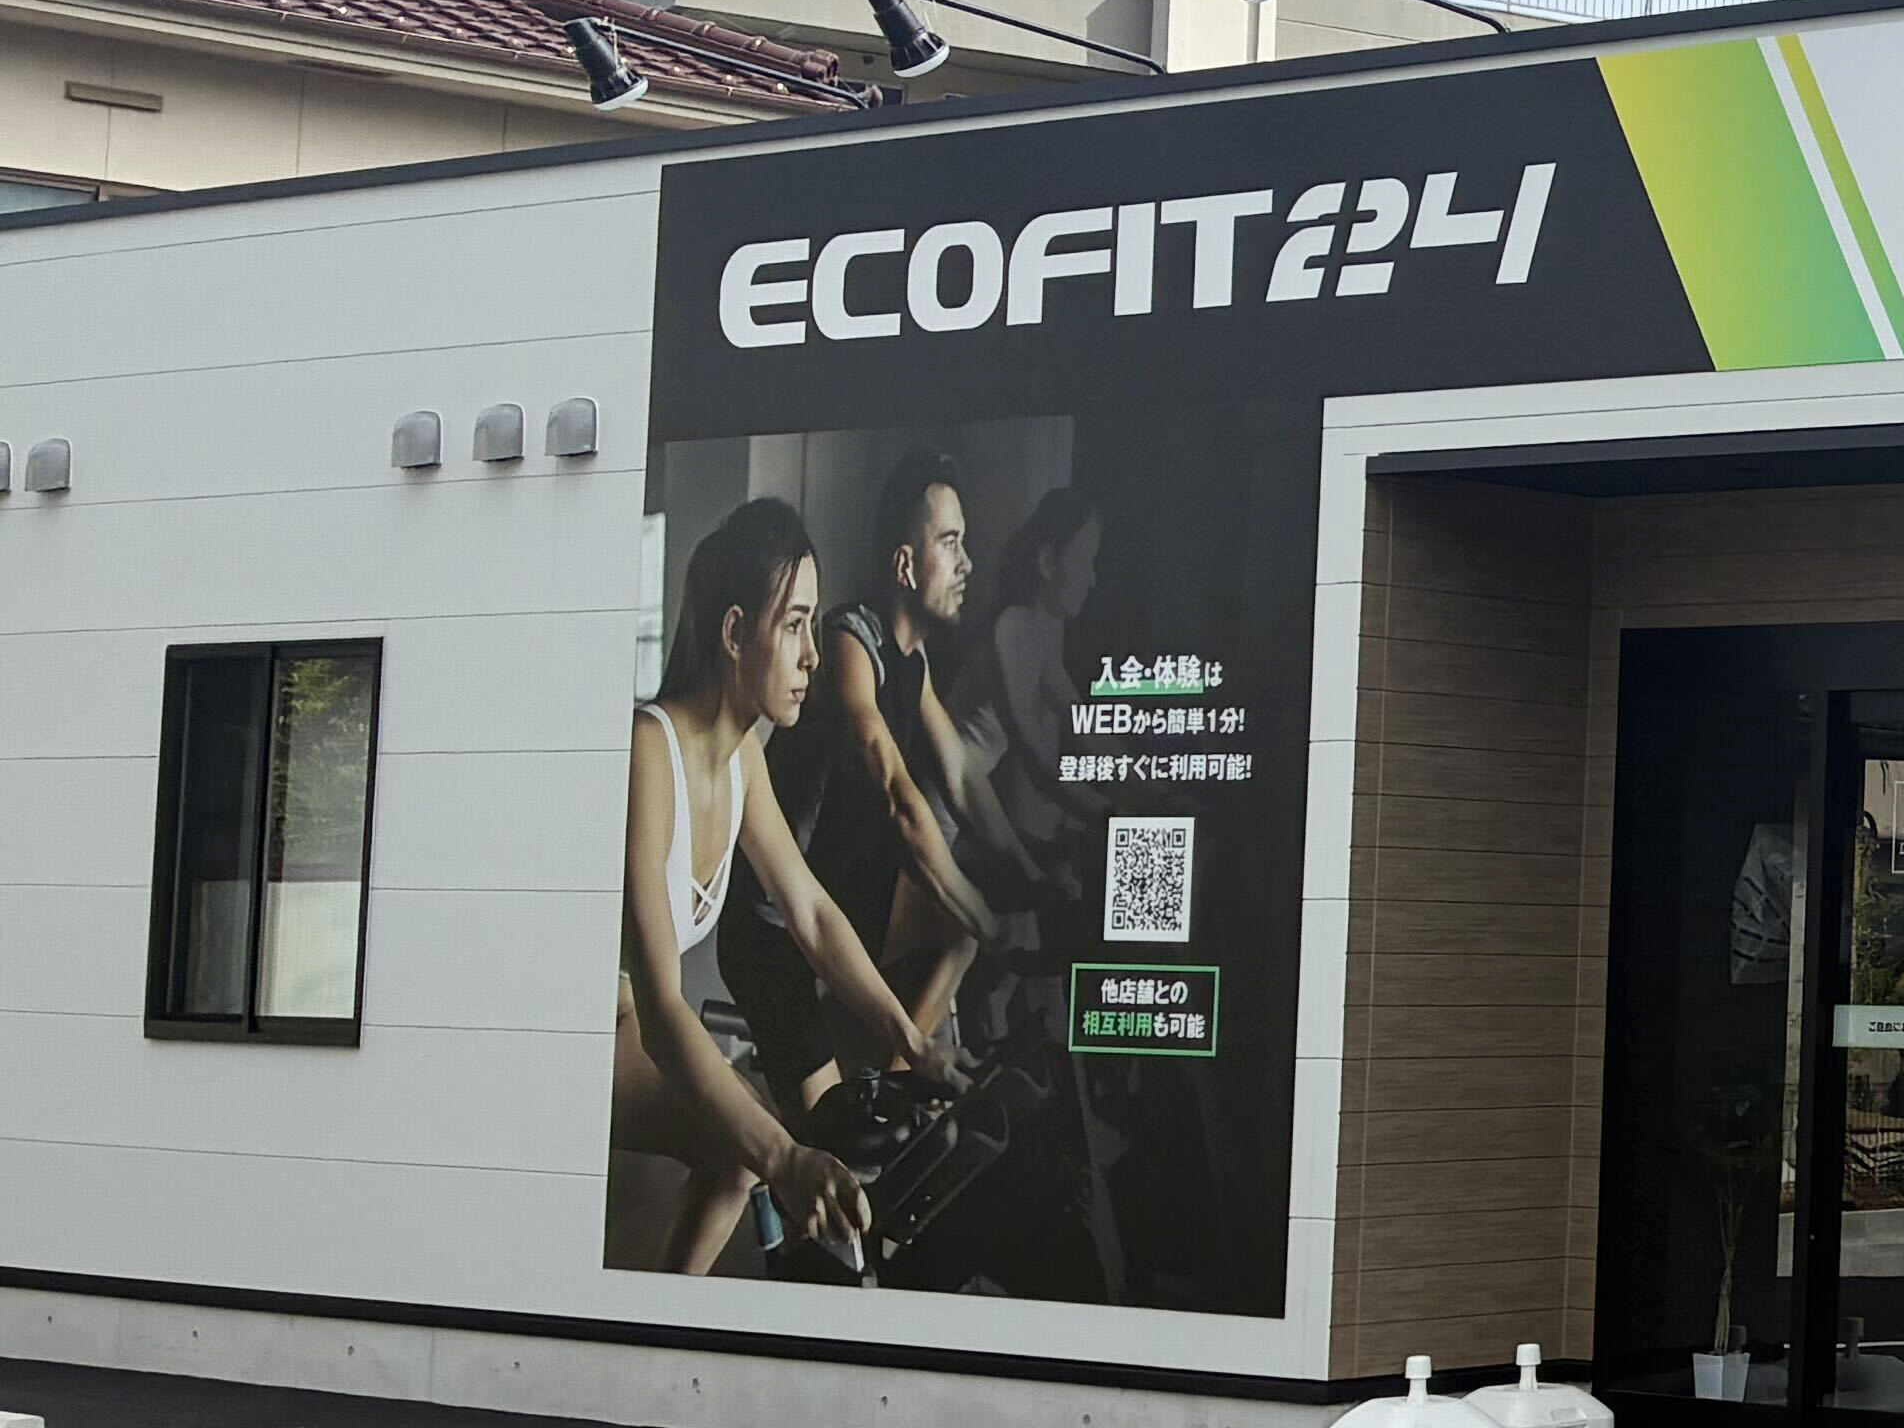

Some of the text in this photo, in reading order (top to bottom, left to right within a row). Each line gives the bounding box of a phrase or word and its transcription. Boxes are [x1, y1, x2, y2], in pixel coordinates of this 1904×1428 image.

[718, 161, 1557, 350] ECOFIT24
[1082, 1010, 1206, 1039] 相互利用も可能
